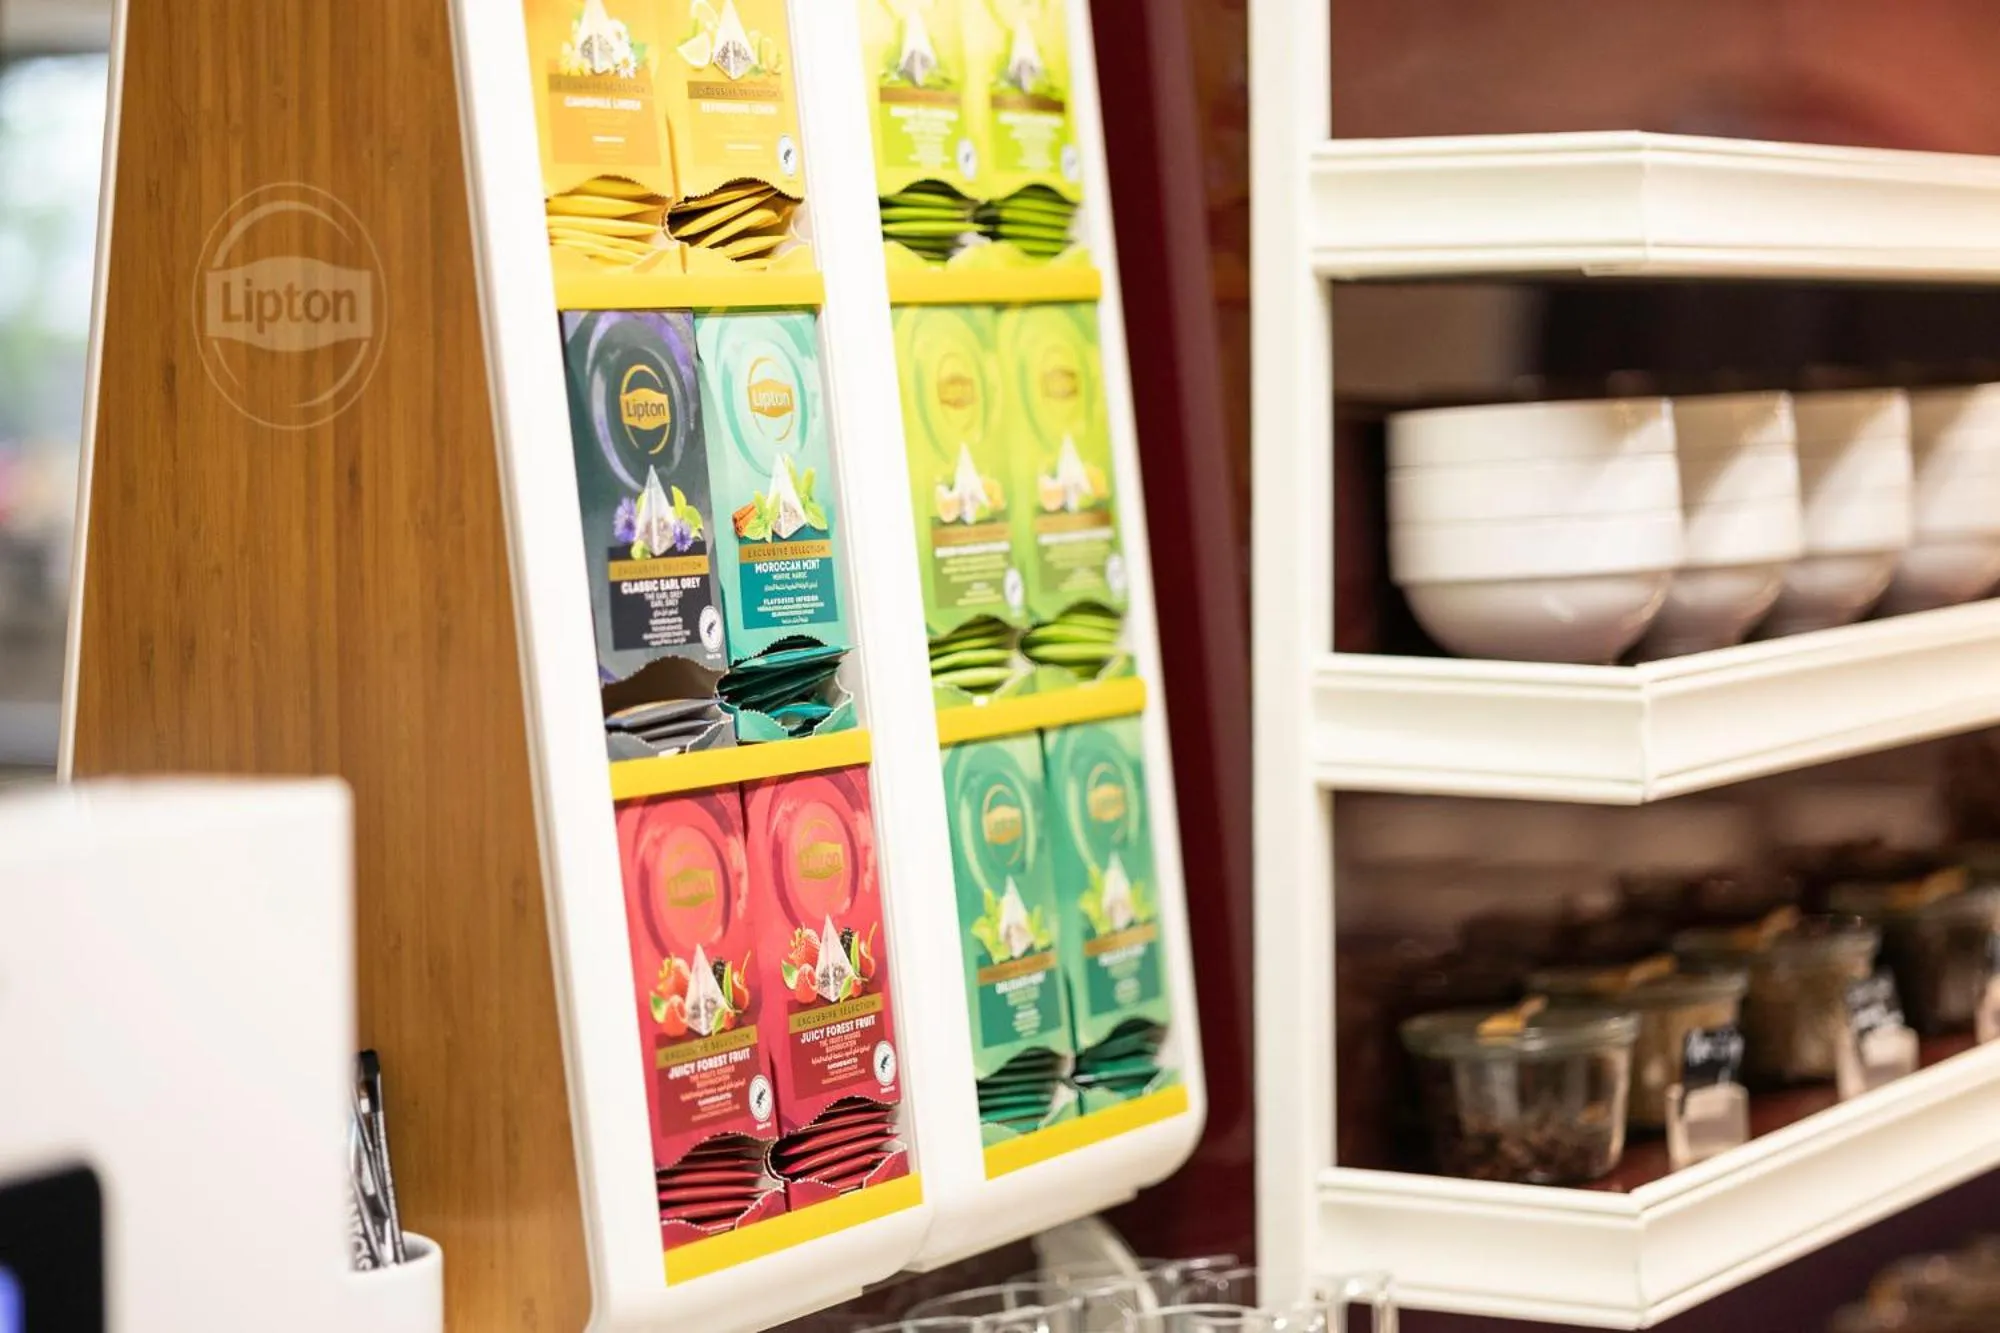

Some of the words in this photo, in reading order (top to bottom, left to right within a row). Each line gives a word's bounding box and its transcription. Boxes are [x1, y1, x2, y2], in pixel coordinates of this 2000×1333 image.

[221, 278, 357, 335] Lipton
[752, 391, 791, 410] Lipton
[626, 401, 666, 423] Lipton
[747, 547, 788, 559] EXCLUSIVE
[755, 560, 802, 574] MOROCCAN
[802, 559, 820, 571] MINT
[621, 580, 659, 595] CLASSIC
[660, 578, 680, 591] EARL
[680, 577, 701, 590] GREY
[800, 1027, 825, 1044] JUICY
[826, 1020, 855, 1038] FOREST
[855, 1014, 876, 1030] FRUIT
[668, 1062, 695, 1080] JUICY
[697, 1054, 728, 1073] FOREST
[728, 1047, 750, 1064] FRUIT
